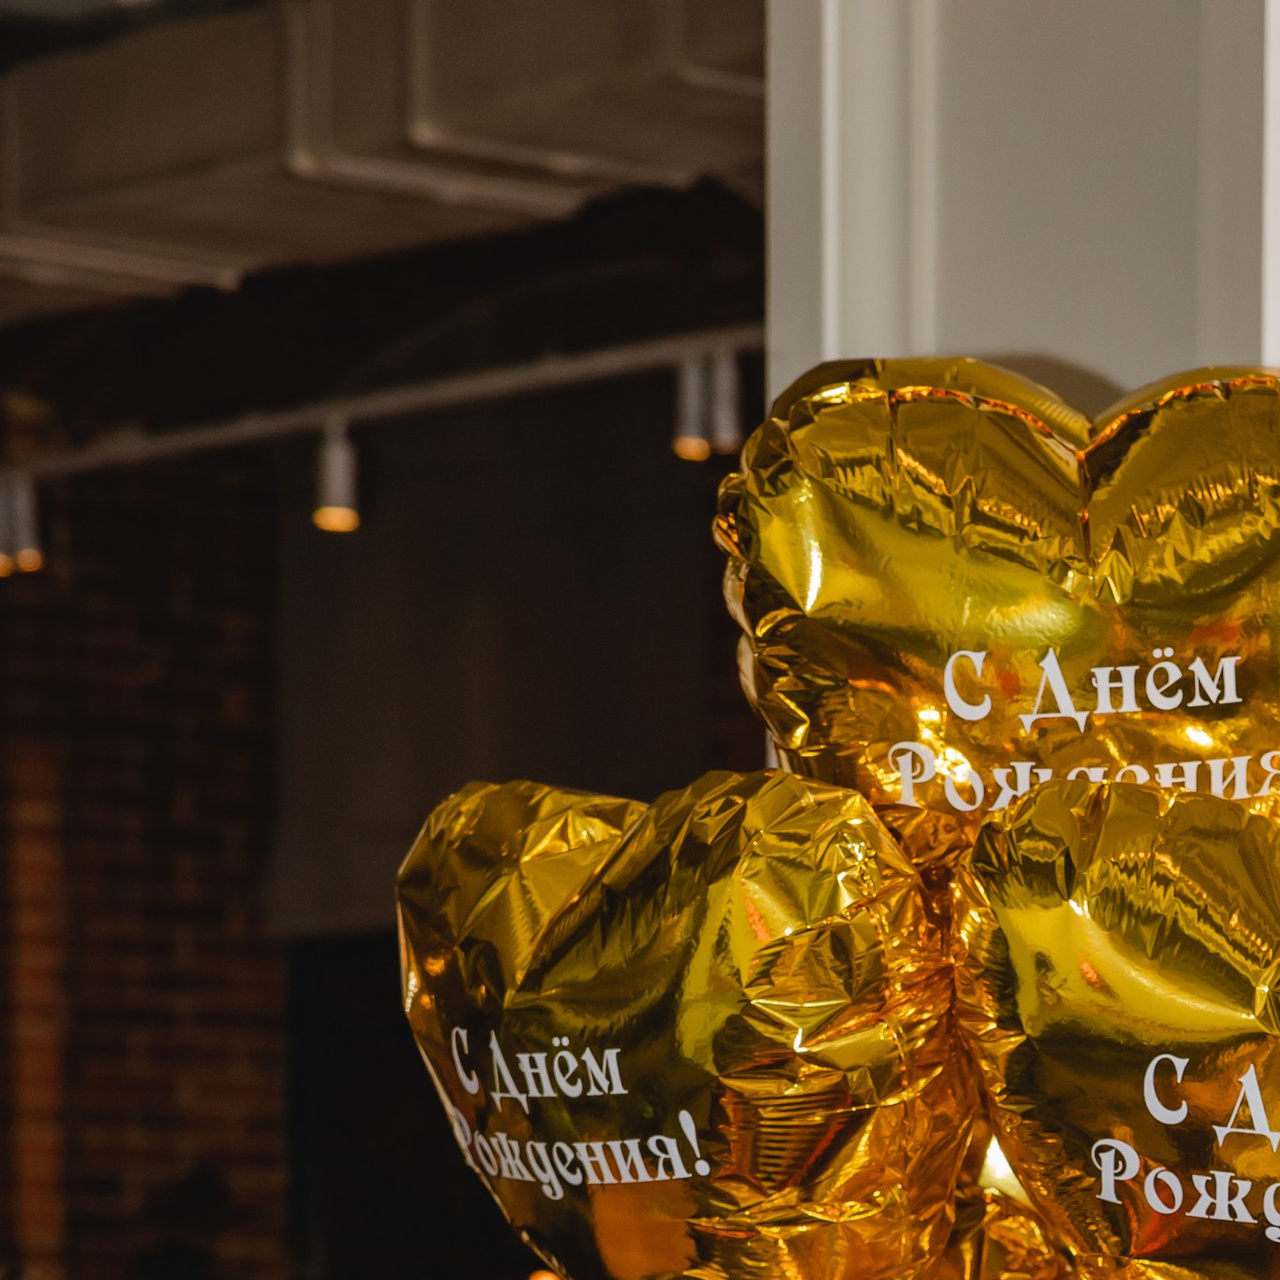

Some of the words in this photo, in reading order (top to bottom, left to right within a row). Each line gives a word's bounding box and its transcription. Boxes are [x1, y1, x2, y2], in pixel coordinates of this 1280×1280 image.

[943, 650, 992, 721] С
[1018, 647, 1243, 735] Днём
[451, 1026, 480, 1096] С
[489, 1029, 629, 1115] Днём
[1143, 1053, 1190, 1125] С
